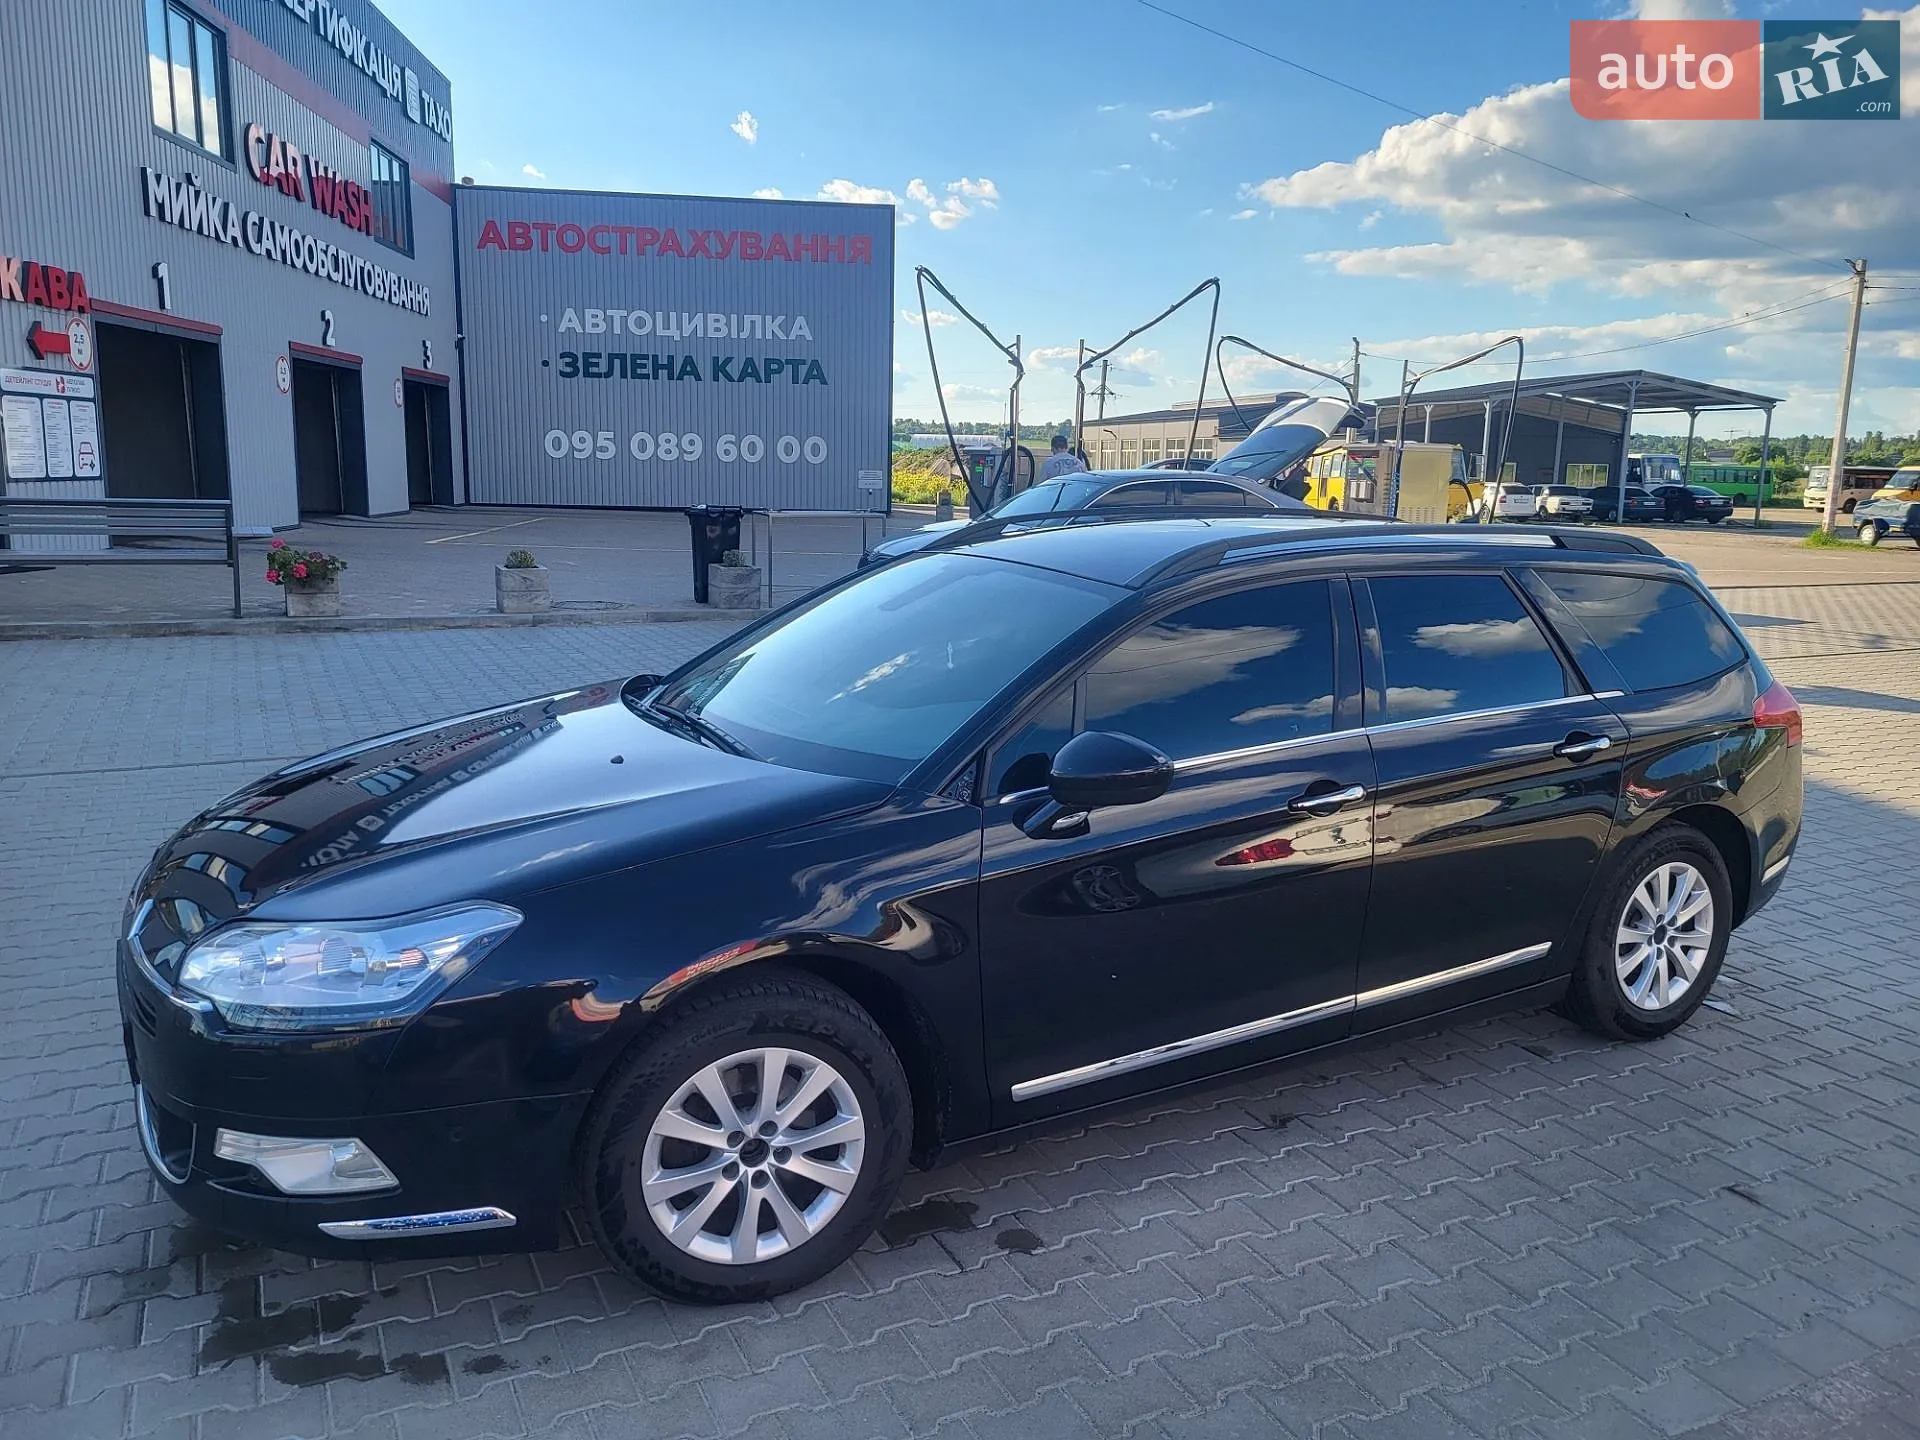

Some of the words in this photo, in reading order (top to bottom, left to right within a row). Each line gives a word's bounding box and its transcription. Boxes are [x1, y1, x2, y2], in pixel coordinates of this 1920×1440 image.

[280, 0, 402, 102] РТИФІКАЦІЯ
[244, 122, 306, 203] CAR
[304, 154, 375, 236] WASH
[141, 166, 243, 248] МИЙКА
[242, 211, 431, 317] САМООБСЛУГОВУВАННЯ
[477, 220, 873, 264] АВТОСТРАХУВАННЯ
[0, 255, 91, 313] КАВА
[152, 262, 171, 309] 1
[321, 309, 336, 347] 2
[558, 307, 813, 341] АВТОЦИВІЛКА
[422, 339, 433, 369] 3
[559, 352, 702, 382] ЗЕЛЕНА
[712, 356, 829, 386] КАРТА
[544, 429, 616, 460] 095
[630, 431, 703, 462] 089
[716, 434, 765, 463] 60
[776, 435, 828, 465] 00
